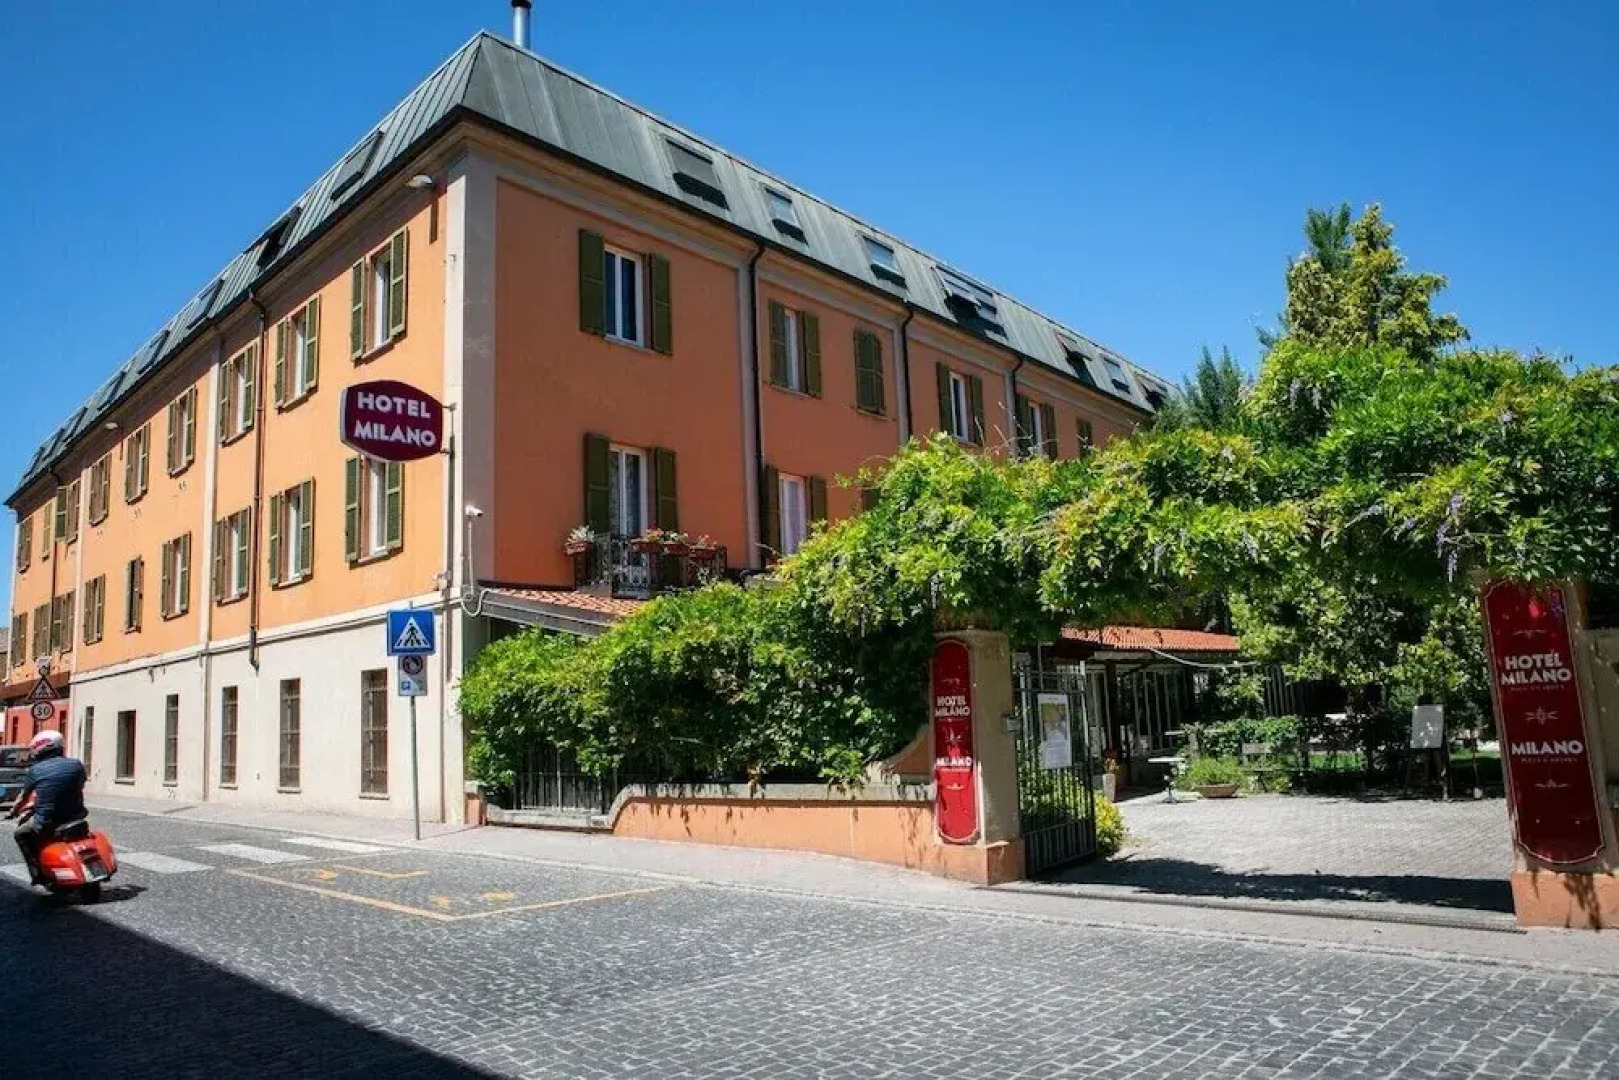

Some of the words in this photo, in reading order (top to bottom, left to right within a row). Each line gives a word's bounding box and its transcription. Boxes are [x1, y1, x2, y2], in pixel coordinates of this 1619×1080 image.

[357, 392, 431, 419] HOTEL
[354, 420, 437, 447] MILANO
[1504, 652, 1563, 670] HOTEL
[1501, 668, 1572, 686] MILANO
[936, 695, 967, 707] HOTEL
[36, 705, 51, 717] 30
[934, 706, 971, 717] MILANO
[1511, 740, 1583, 756] MILANO
[936, 756, 972, 767] MILANO
